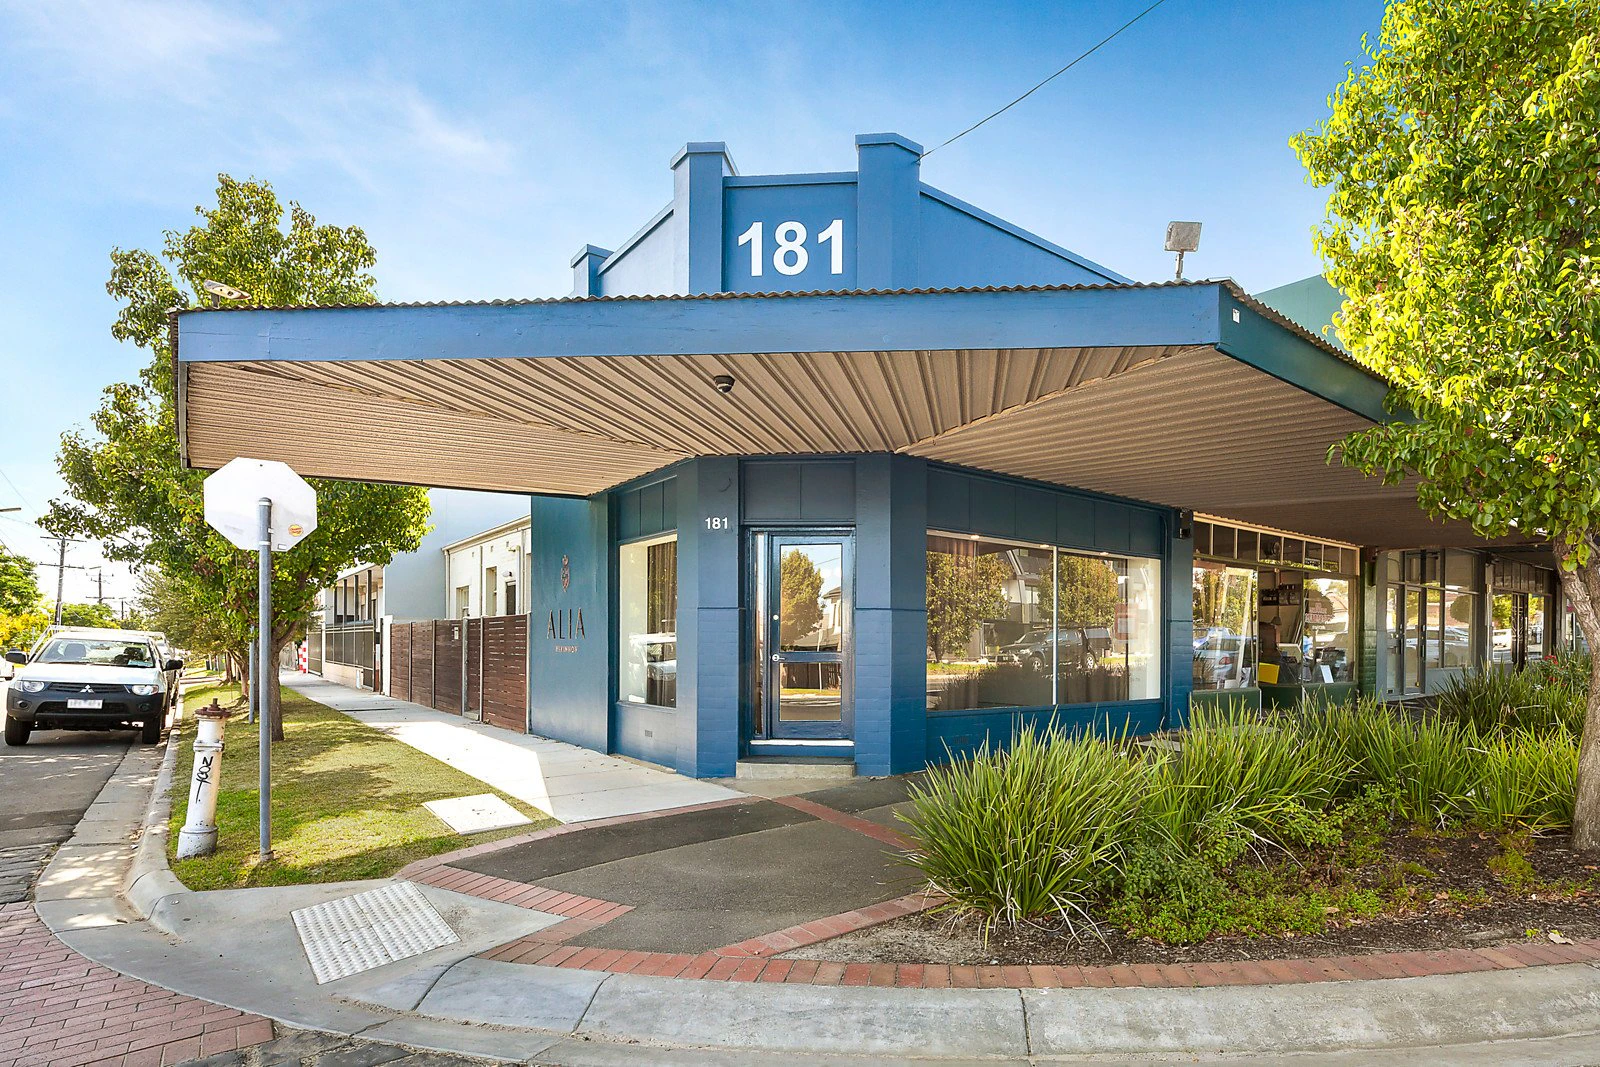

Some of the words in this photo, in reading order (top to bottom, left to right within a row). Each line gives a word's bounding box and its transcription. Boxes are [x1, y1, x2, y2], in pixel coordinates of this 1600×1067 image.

[737, 219, 844, 277] 181
[704, 517, 729, 530] 181
[546, 607, 586, 640] ALIA
